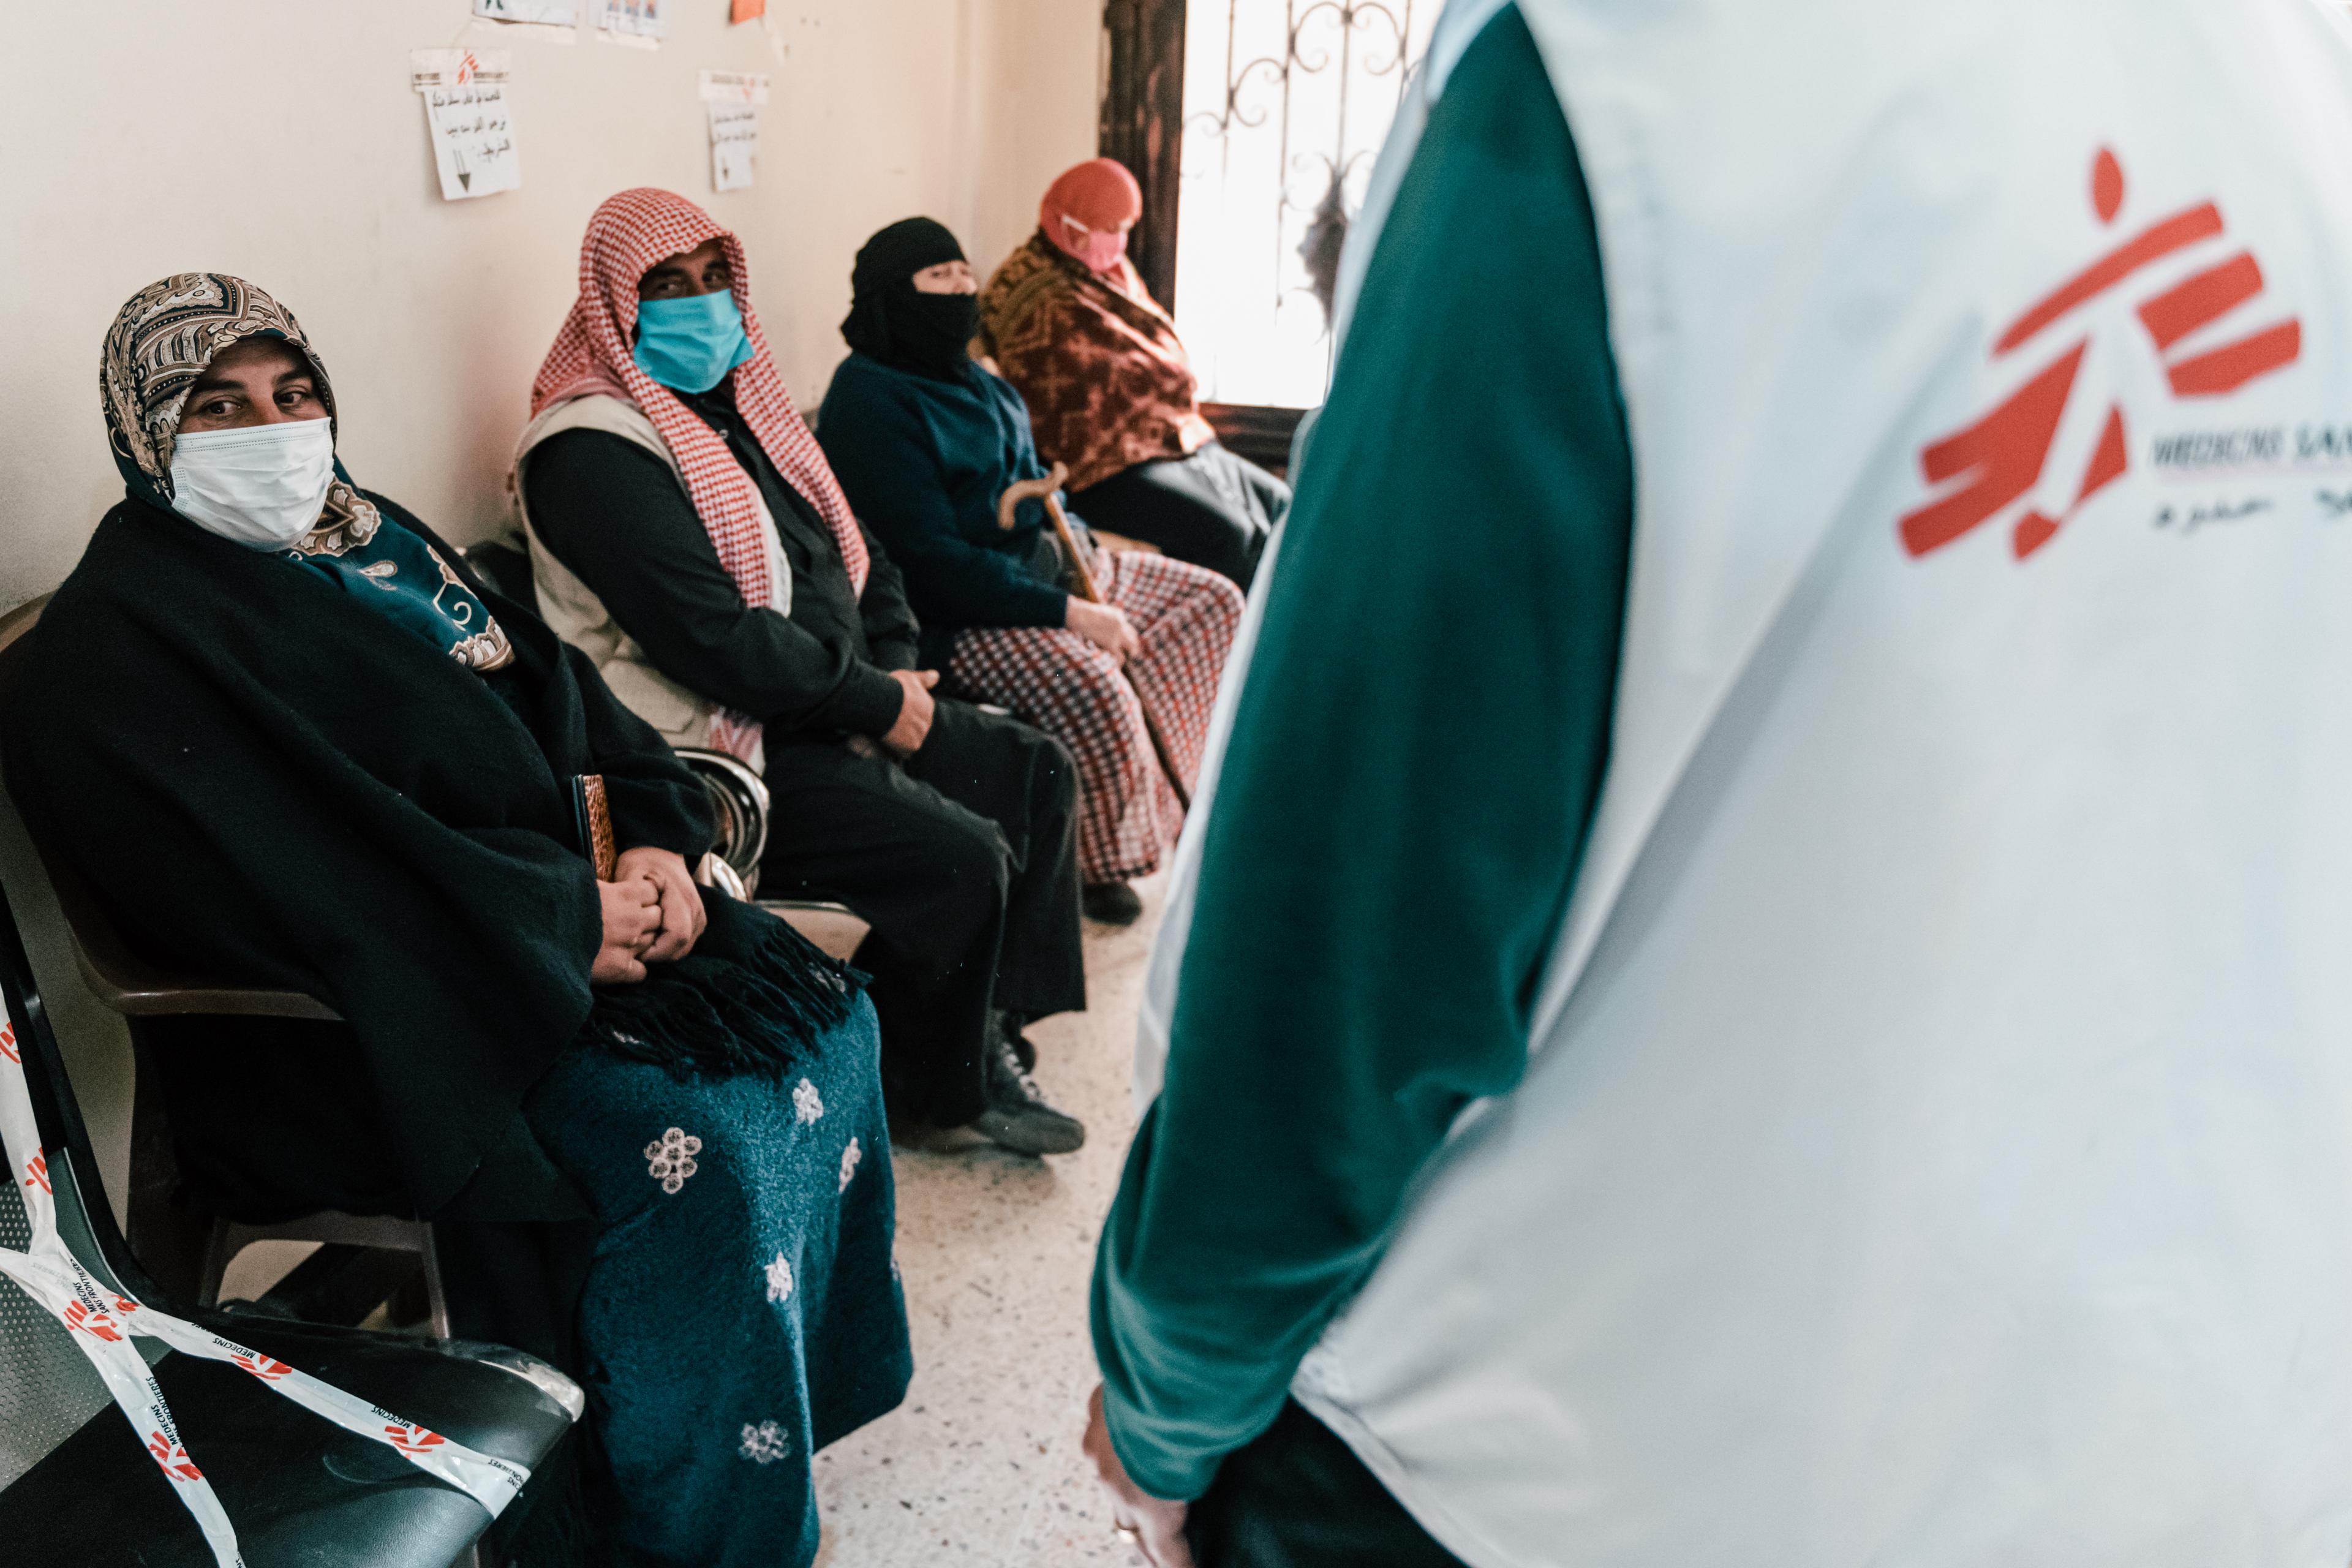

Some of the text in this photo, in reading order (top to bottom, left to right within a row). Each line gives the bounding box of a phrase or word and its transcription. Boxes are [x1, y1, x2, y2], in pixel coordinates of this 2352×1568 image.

[73, 1281, 97, 1313] MEDECINS
[94, 1298, 110, 1314] SANS
[212, 1337, 257, 1359] MEDECINS
[145, 1376, 175, 1424] FRONTIERES
[151, 1404, 178, 1445] MEDECINS
[371, 1406, 412, 1428] MEDECINS
